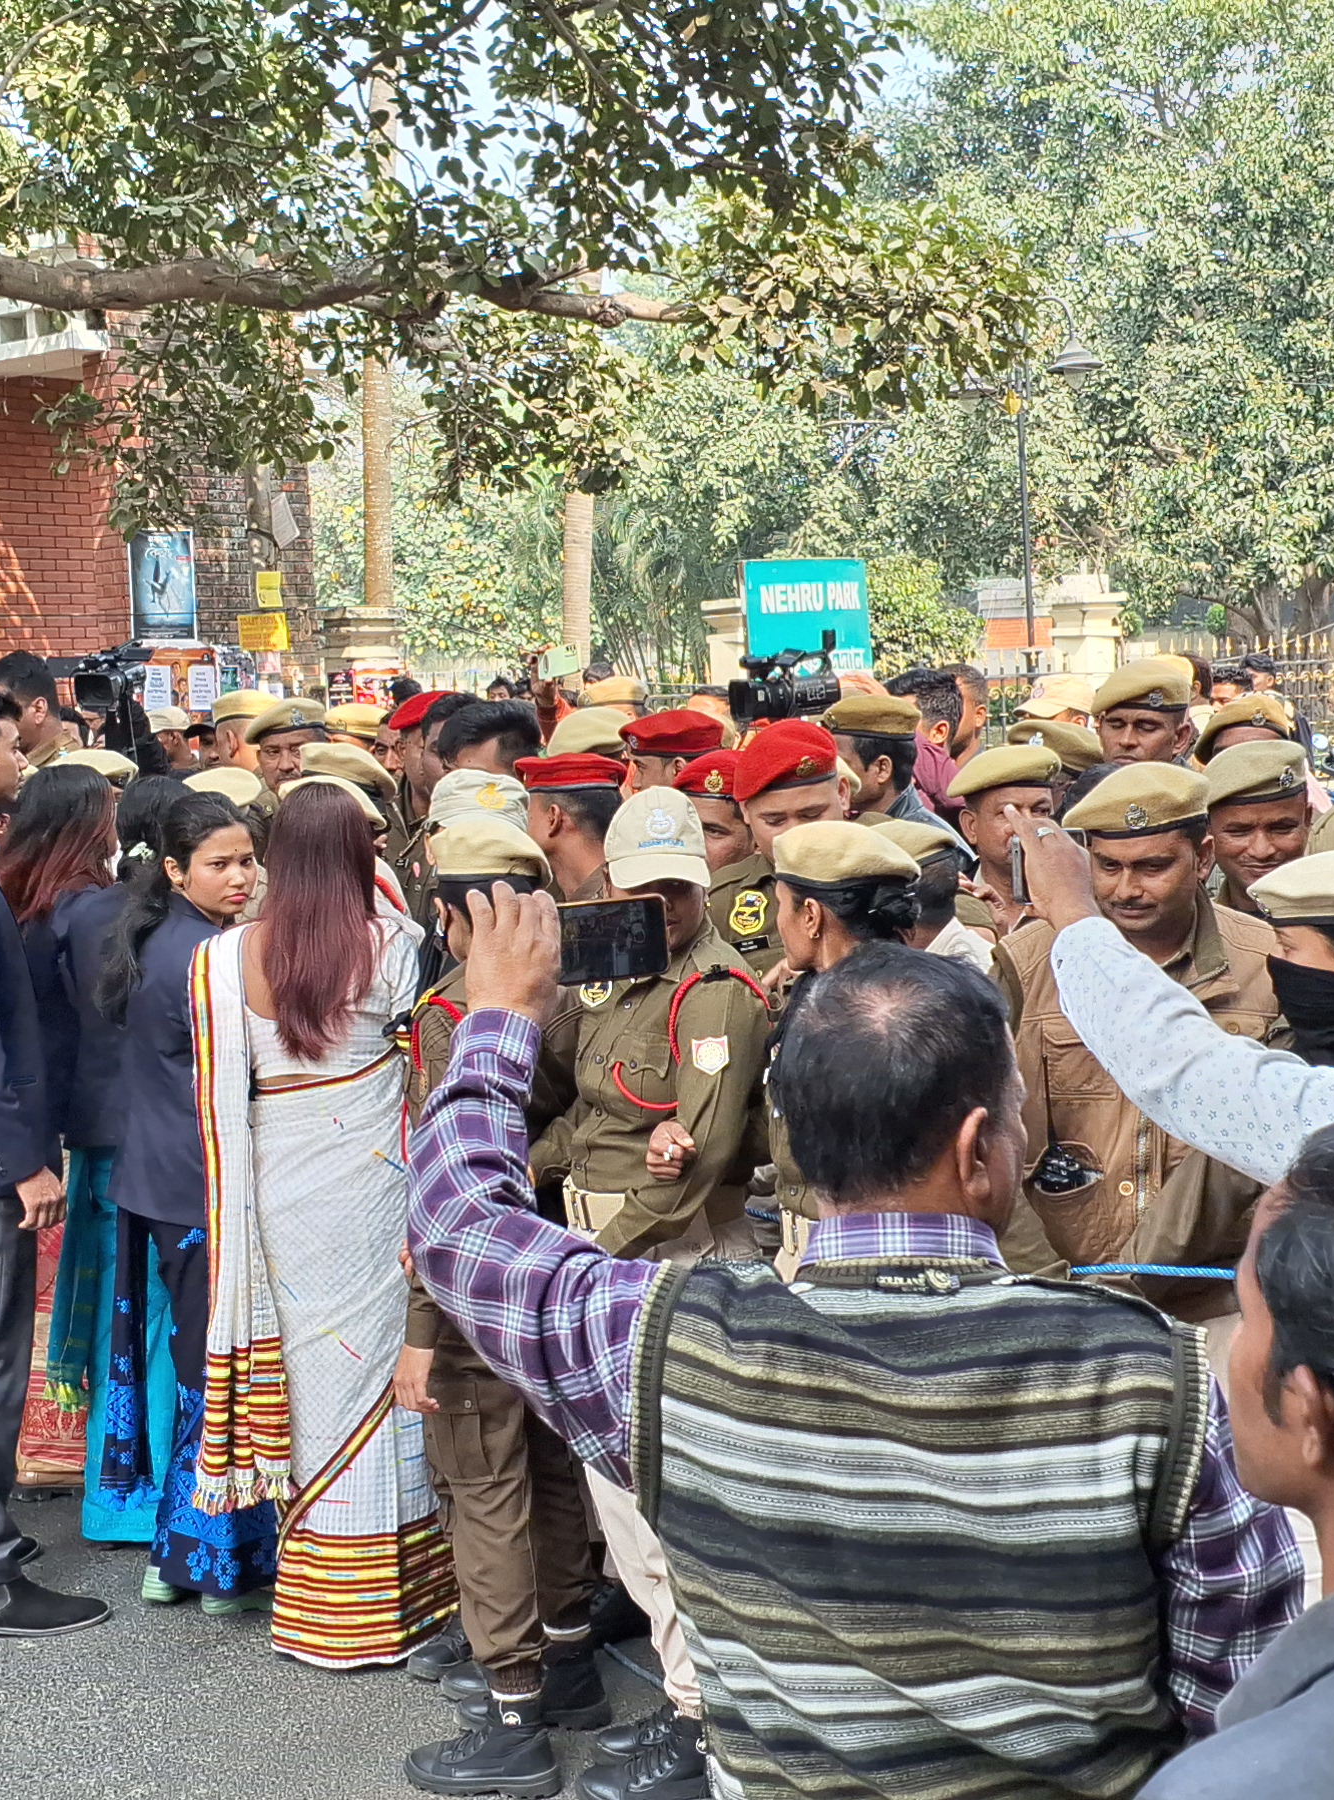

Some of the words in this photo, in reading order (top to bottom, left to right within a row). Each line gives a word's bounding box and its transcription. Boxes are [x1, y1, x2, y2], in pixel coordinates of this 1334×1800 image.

[759, 583, 824, 614] NEHRU
[826, 581, 861, 611] PARK
[638, 840, 663, 848] ASSAM
